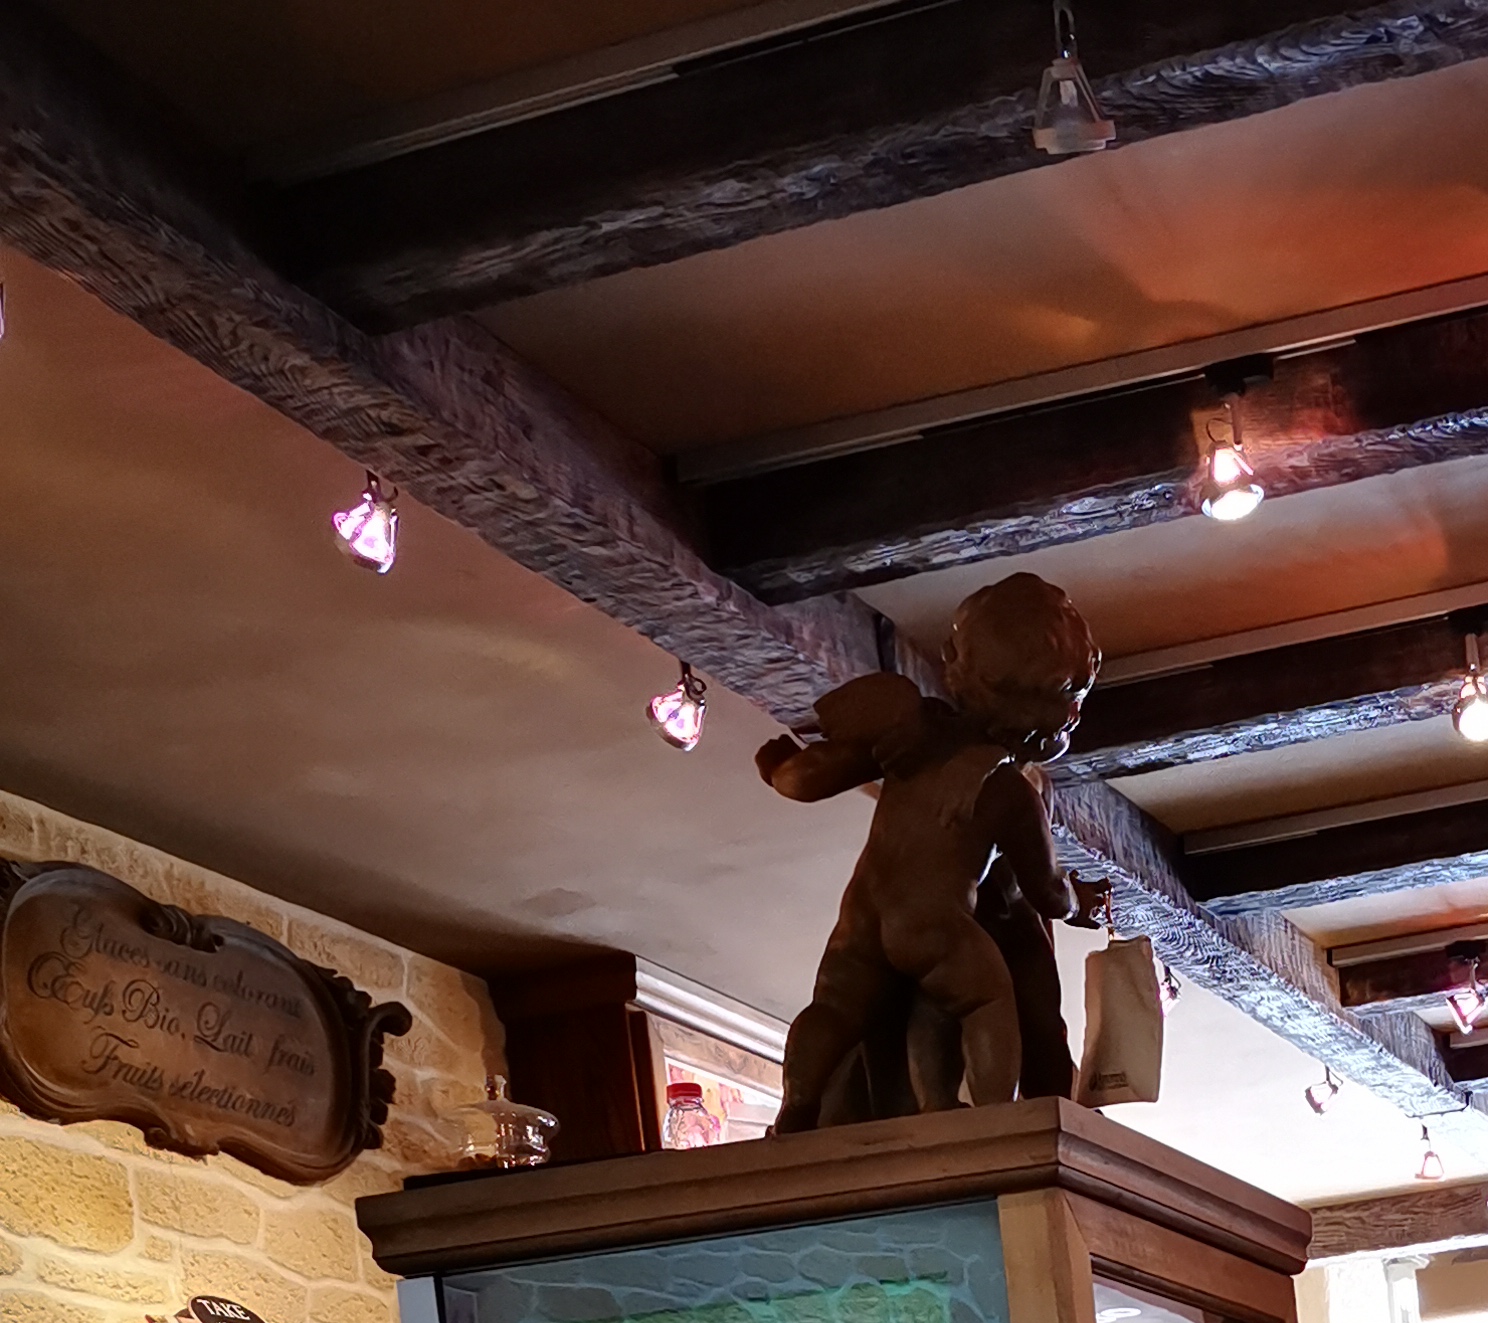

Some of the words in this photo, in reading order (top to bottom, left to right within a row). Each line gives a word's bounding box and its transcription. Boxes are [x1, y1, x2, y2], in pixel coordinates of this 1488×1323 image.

[60, 902, 150, 969] Glaces
[82, 1026, 165, 1092] Fruits
[194, 1002, 254, 1056] Lait
[265, 1034, 315, 1076] frais
[196, 1299, 251, 1320] TAKE
